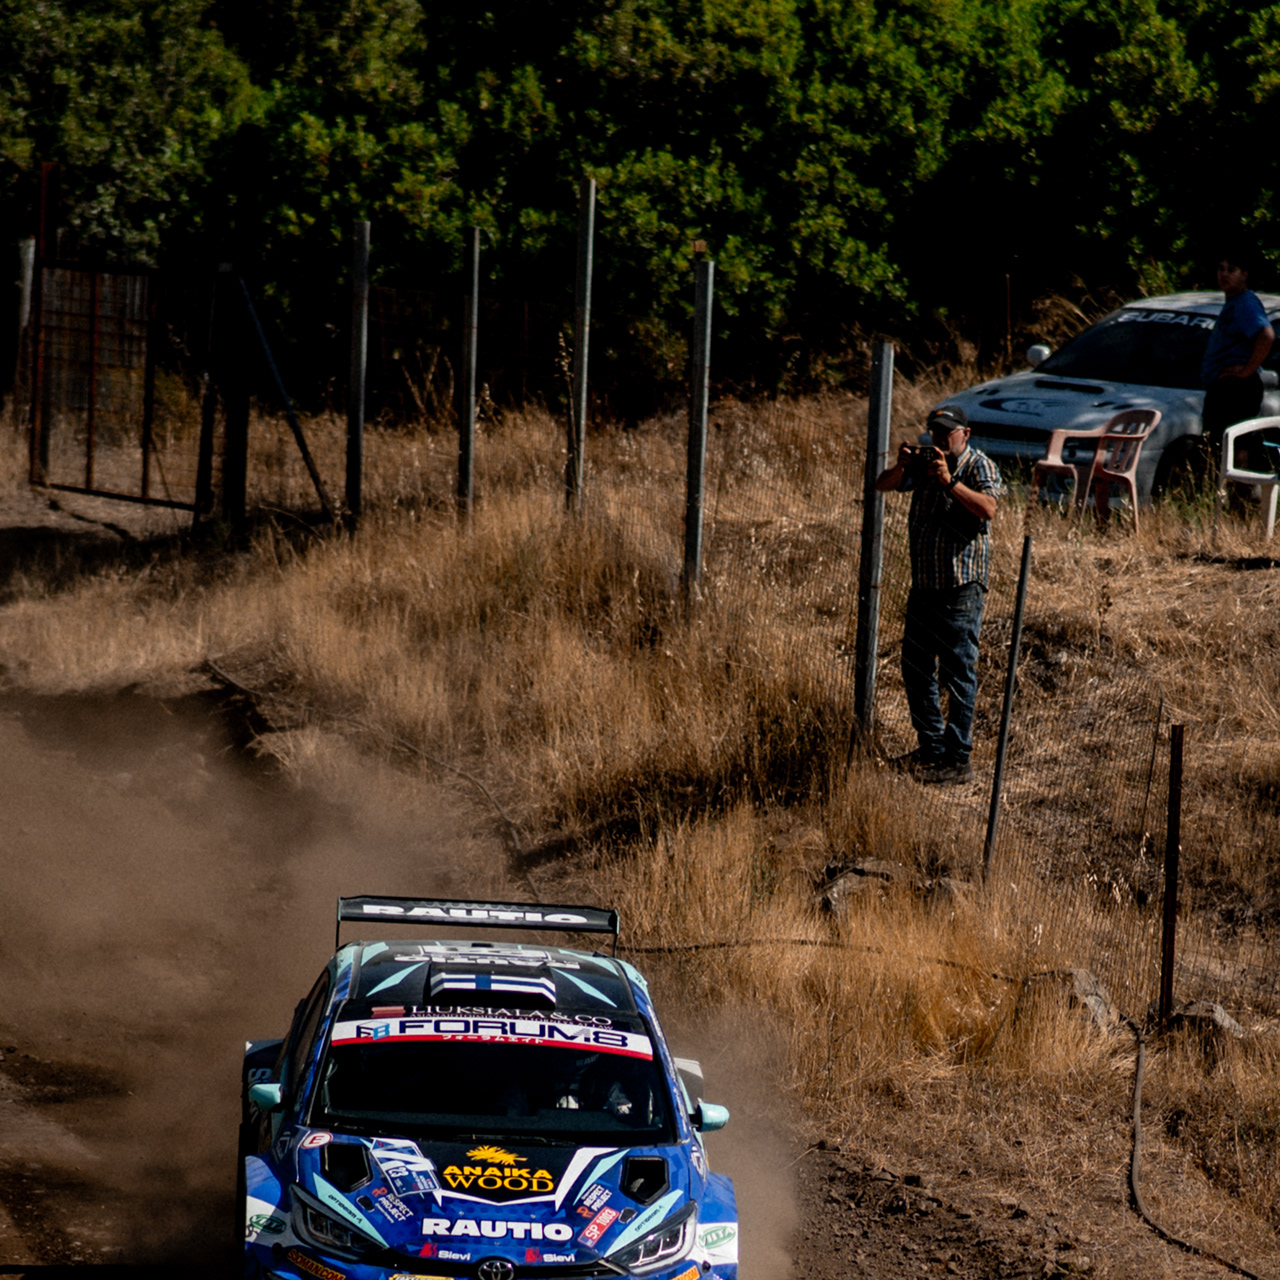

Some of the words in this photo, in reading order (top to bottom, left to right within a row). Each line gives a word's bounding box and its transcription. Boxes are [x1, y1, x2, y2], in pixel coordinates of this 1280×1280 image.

[363, 904, 587, 923] RAUTIO
[410, 1006, 545, 1018] LIUKSIALA
[550, 1012, 573, 1020] &
[575, 1014, 613, 1025] CO
[399, 1020, 628, 1047] FORUM8
[443, 1165, 553, 1179] ANAIKA
[444, 1175, 555, 1192] WOOD
[386, 1193, 414, 1217] RESPECT
[583, 1185, 605, 1207] RESPECT
[591, 1189, 613, 1211] PROJECT
[378, 1197, 406, 1221] PROJECT
[422, 1218, 573, 1241] RAUTIO
[585, 1224, 600, 1240] SP
[596, 1209, 616, 1226] 1003
[438, 1250, 471, 1261] Sievi
[543, 1253, 576, 1263] Sievi
